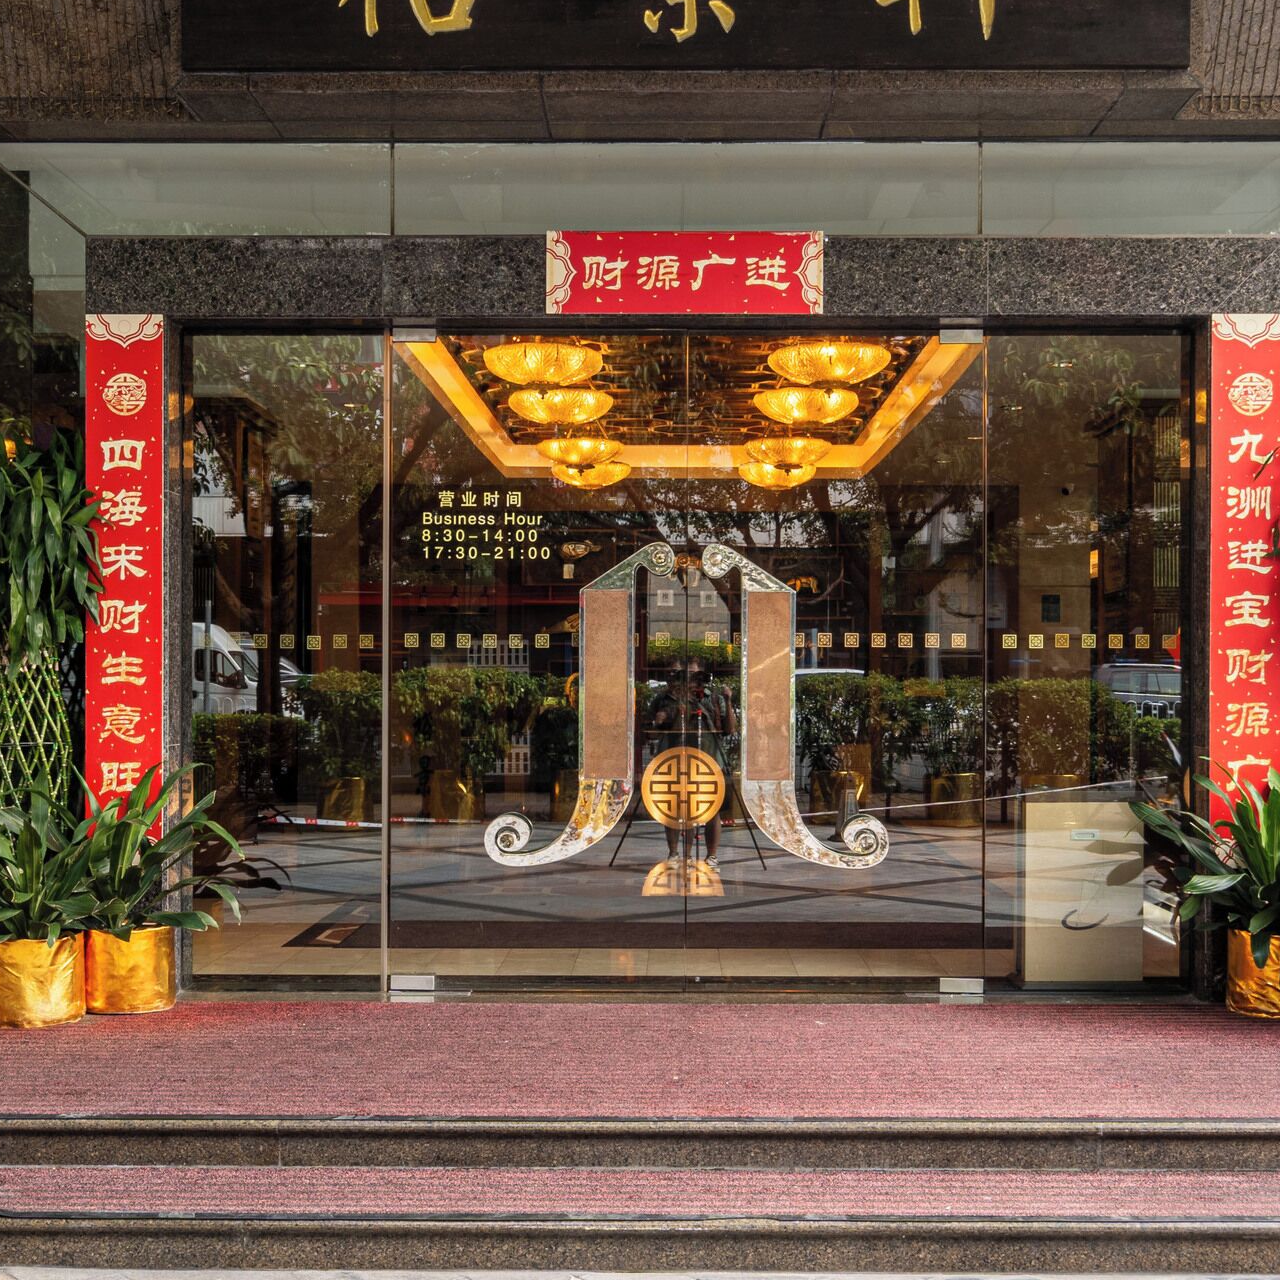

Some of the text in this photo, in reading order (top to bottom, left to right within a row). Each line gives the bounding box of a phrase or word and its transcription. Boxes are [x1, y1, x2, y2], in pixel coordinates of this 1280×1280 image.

[582, 254, 791, 291] 财源广进
[438, 490, 521, 508] 营业时间
[422, 512, 543, 525] Business Hour
[422, 529, 538, 542] 8:30-14:00
[422, 546, 550, 559] 17:30-21:00
[100, 438, 148, 796] 四海来财生意旺
